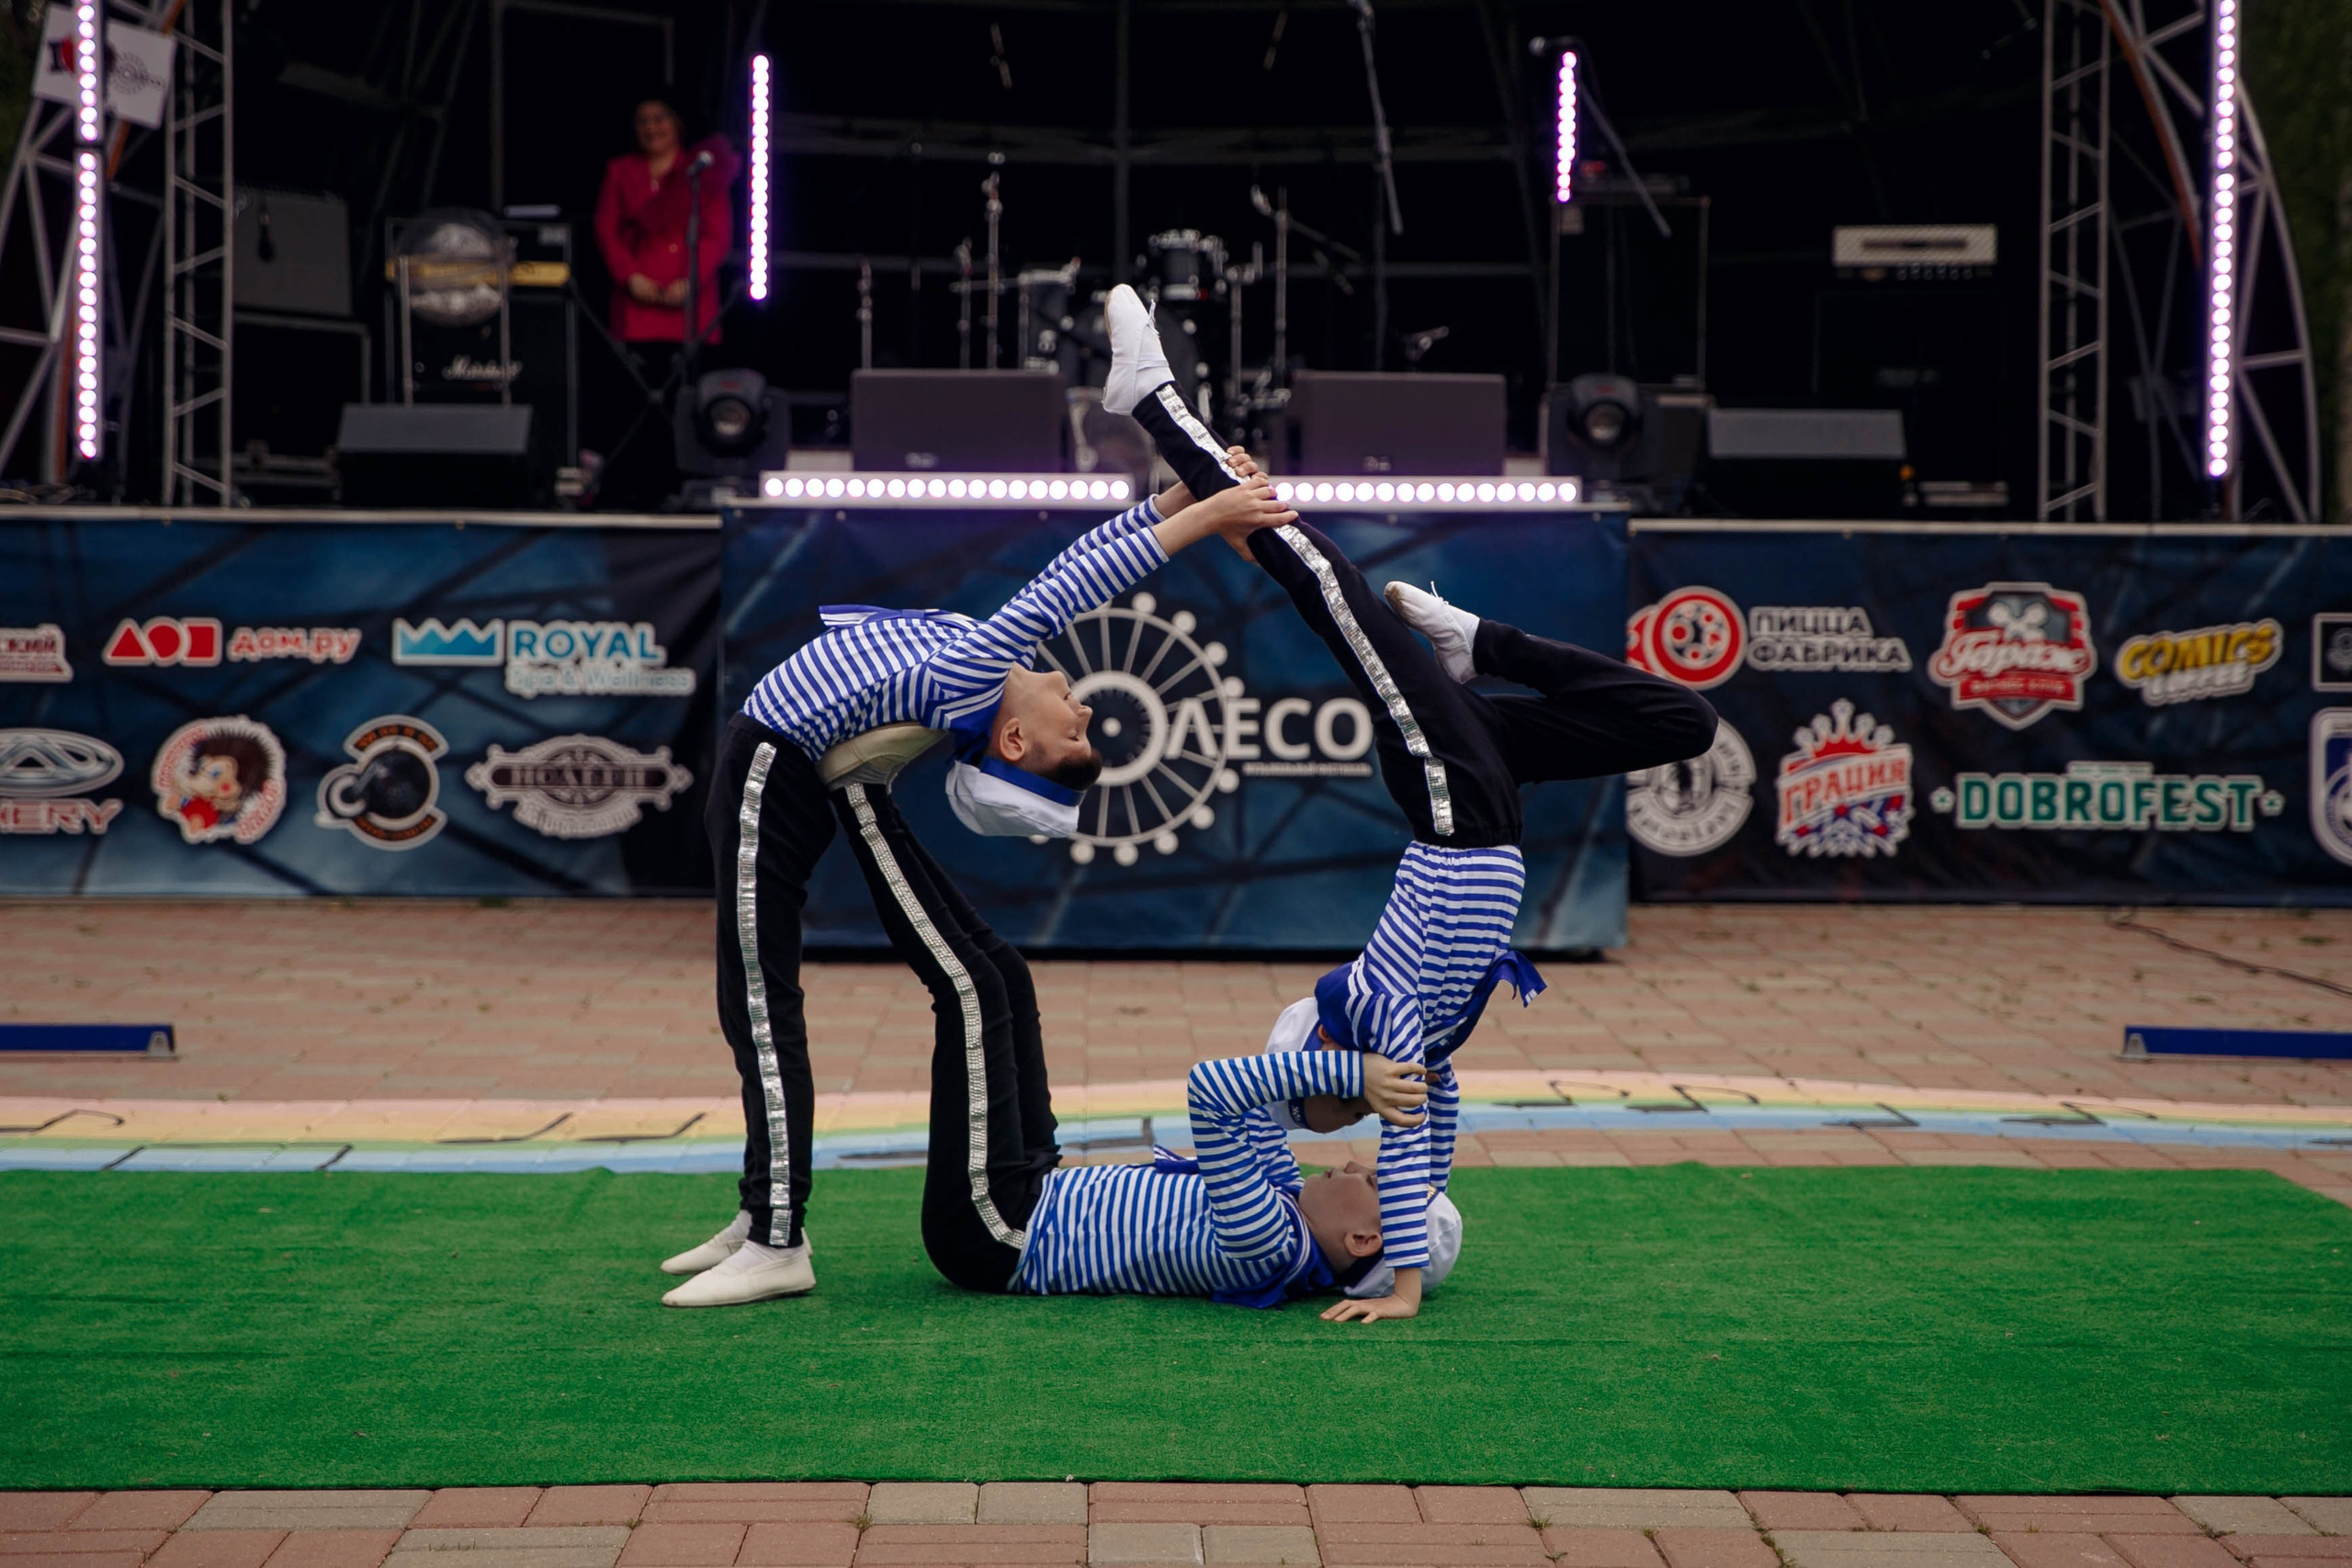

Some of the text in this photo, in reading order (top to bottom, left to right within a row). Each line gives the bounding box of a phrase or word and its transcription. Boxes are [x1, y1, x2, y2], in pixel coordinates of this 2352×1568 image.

[1753, 611, 1869, 636] ПИЦЦА
[514, 627, 661, 659] ROYAL
[1750, 640, 1907, 665] ФАБРИКА
[2120, 624, 2276, 681] COMICS
[1785, 759, 1906, 825] ГРАЦИЯ
[1962, 779, 2258, 824] DOBROFEST
